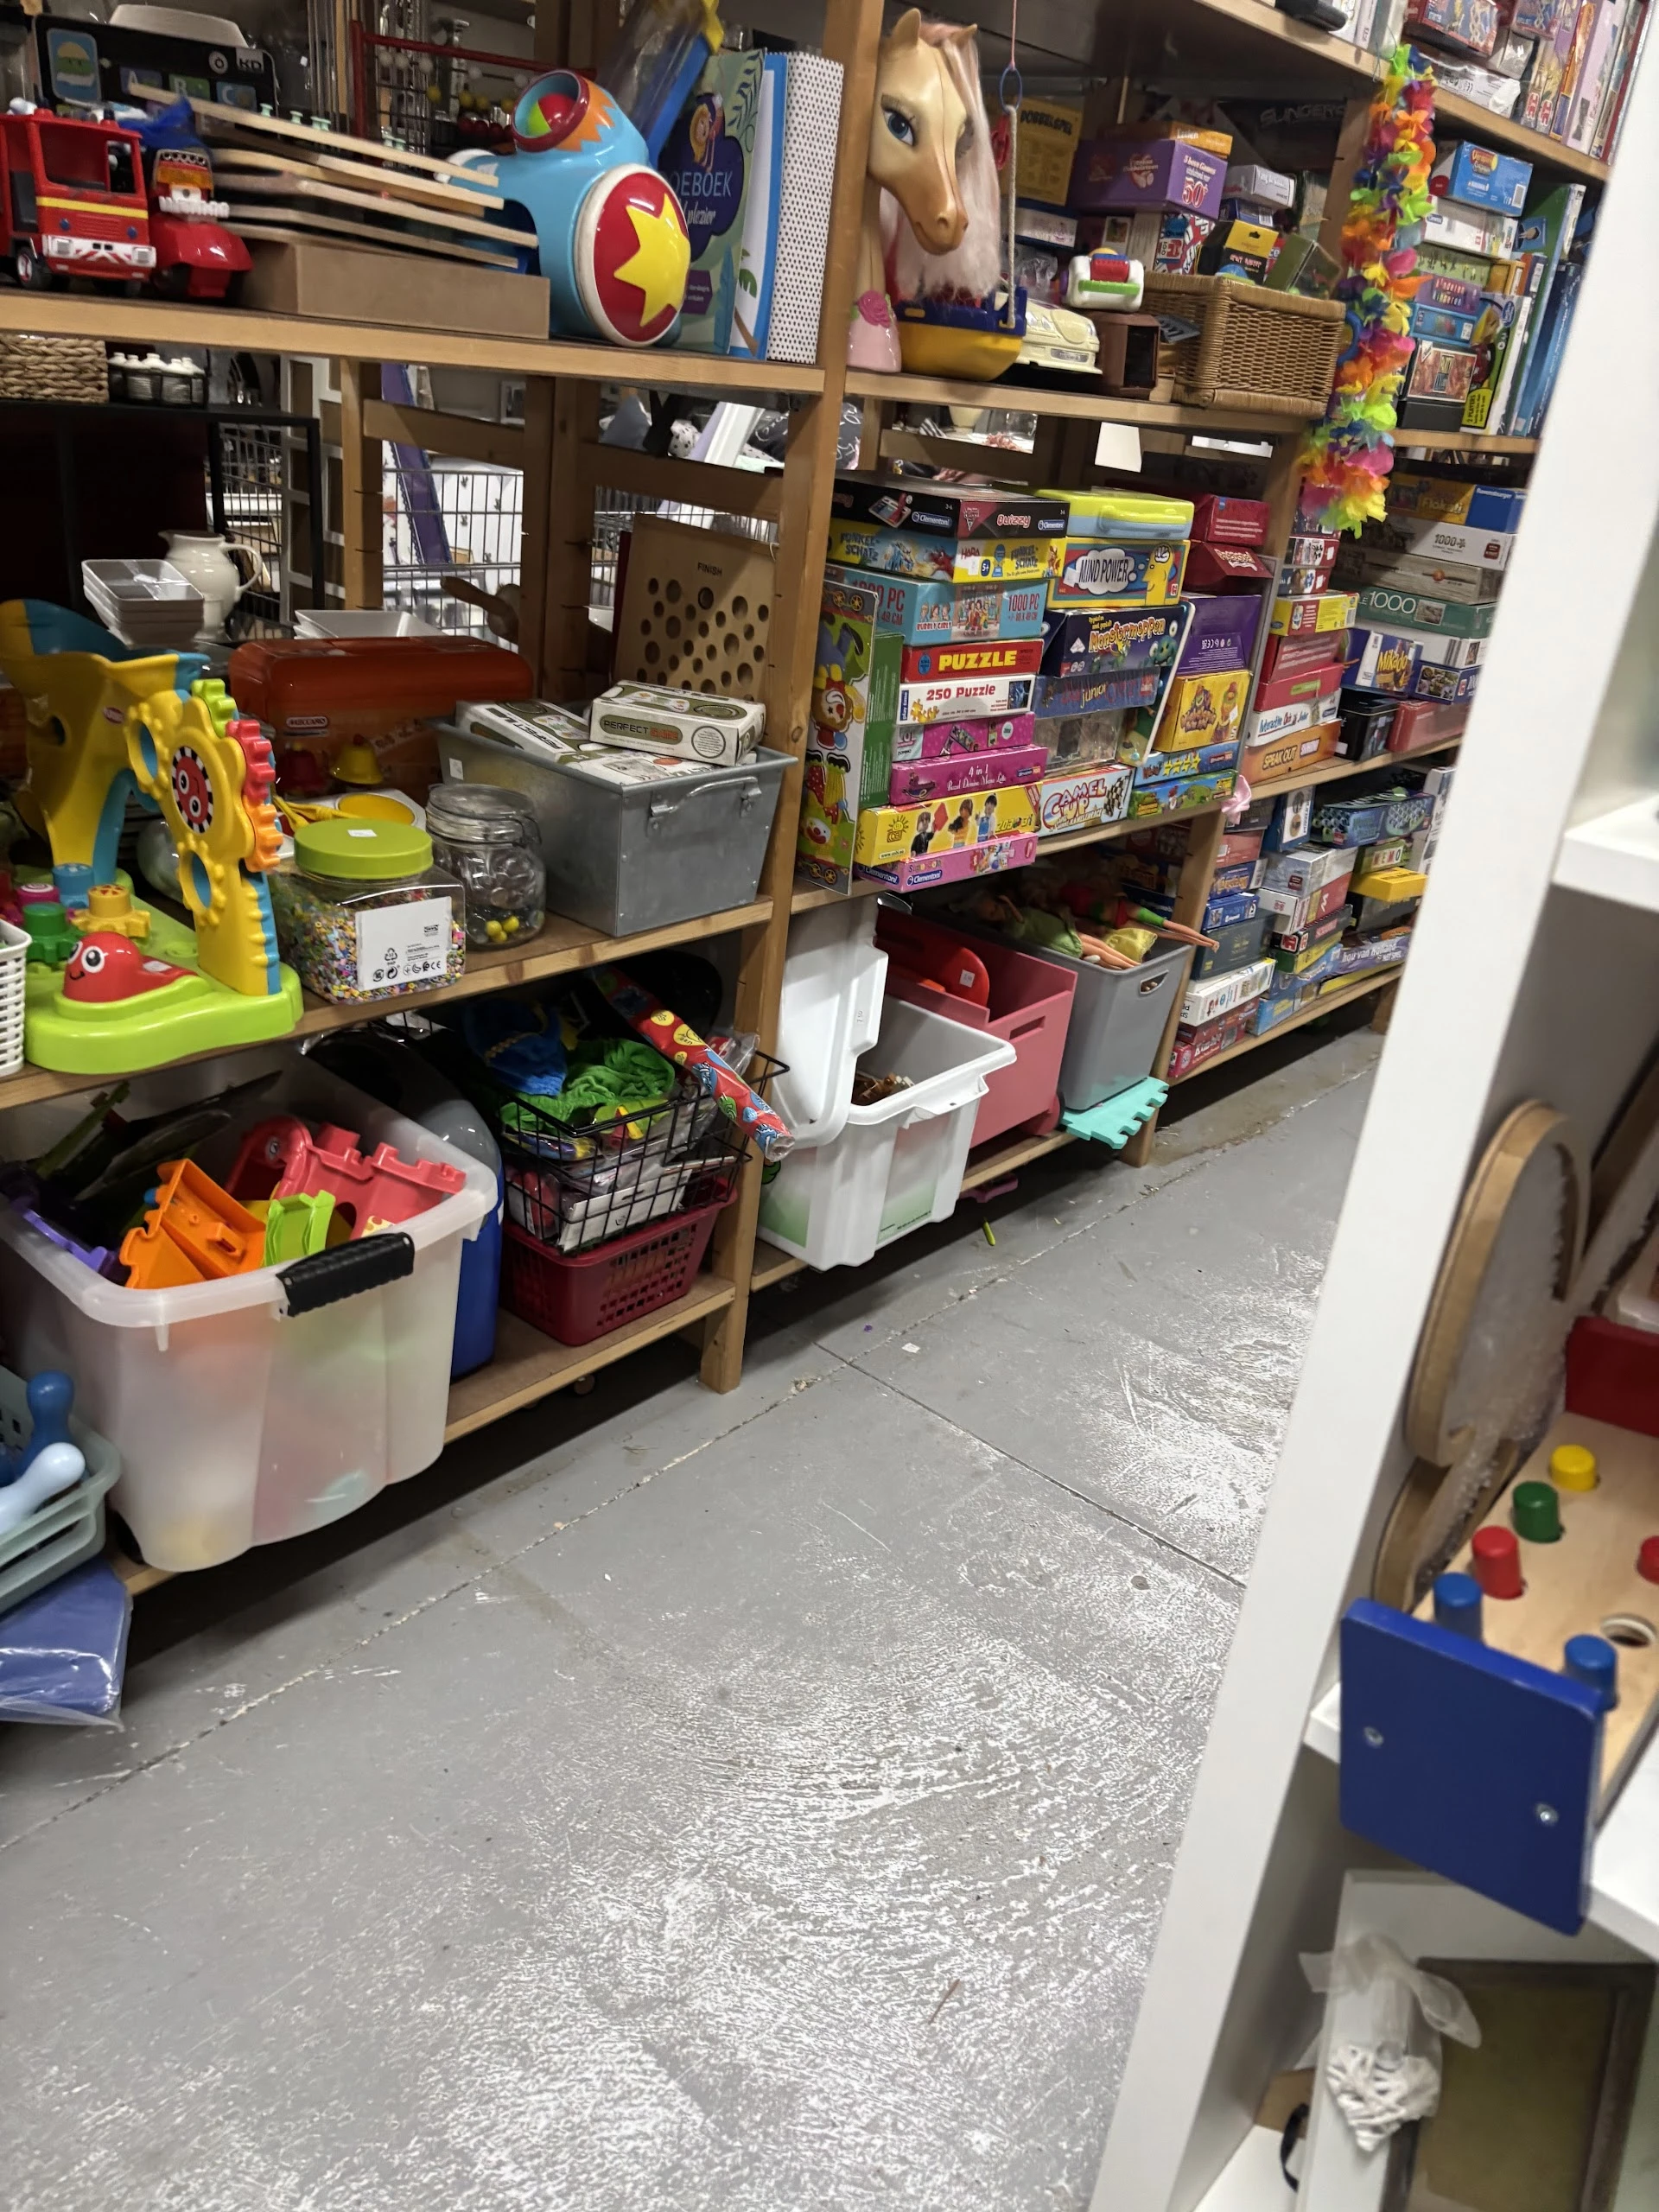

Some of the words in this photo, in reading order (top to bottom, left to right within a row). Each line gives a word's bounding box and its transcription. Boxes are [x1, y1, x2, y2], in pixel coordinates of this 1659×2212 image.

[669, 171, 734, 198] OEBOEK
[919, 514, 950, 526] Clementoni
[996, 514, 1032, 529] Quizzy
[1434, 533, 1457, 548] 1000
[697, 562, 723, 577] FINISH
[1078, 559, 1100, 584] MIND
[1100, 558, 1128, 583] POWER
[1008, 594, 1028, 612] 1000
[1370, 591, 1417, 614] 1000
[938, 650, 1018, 671] PUZZLE
[1376, 648, 1408, 672] Mikado
[925, 688, 952, 701] 250
[956, 683, 996, 699] Puzzle
[604, 720, 649, 735] PERFECT
[1263, 749, 1283, 769] SPEAK
[1282, 745, 1298, 762] OUT
[1042, 778, 1107, 830] CAMEL
[913, 870, 941, 883] Clementoni
